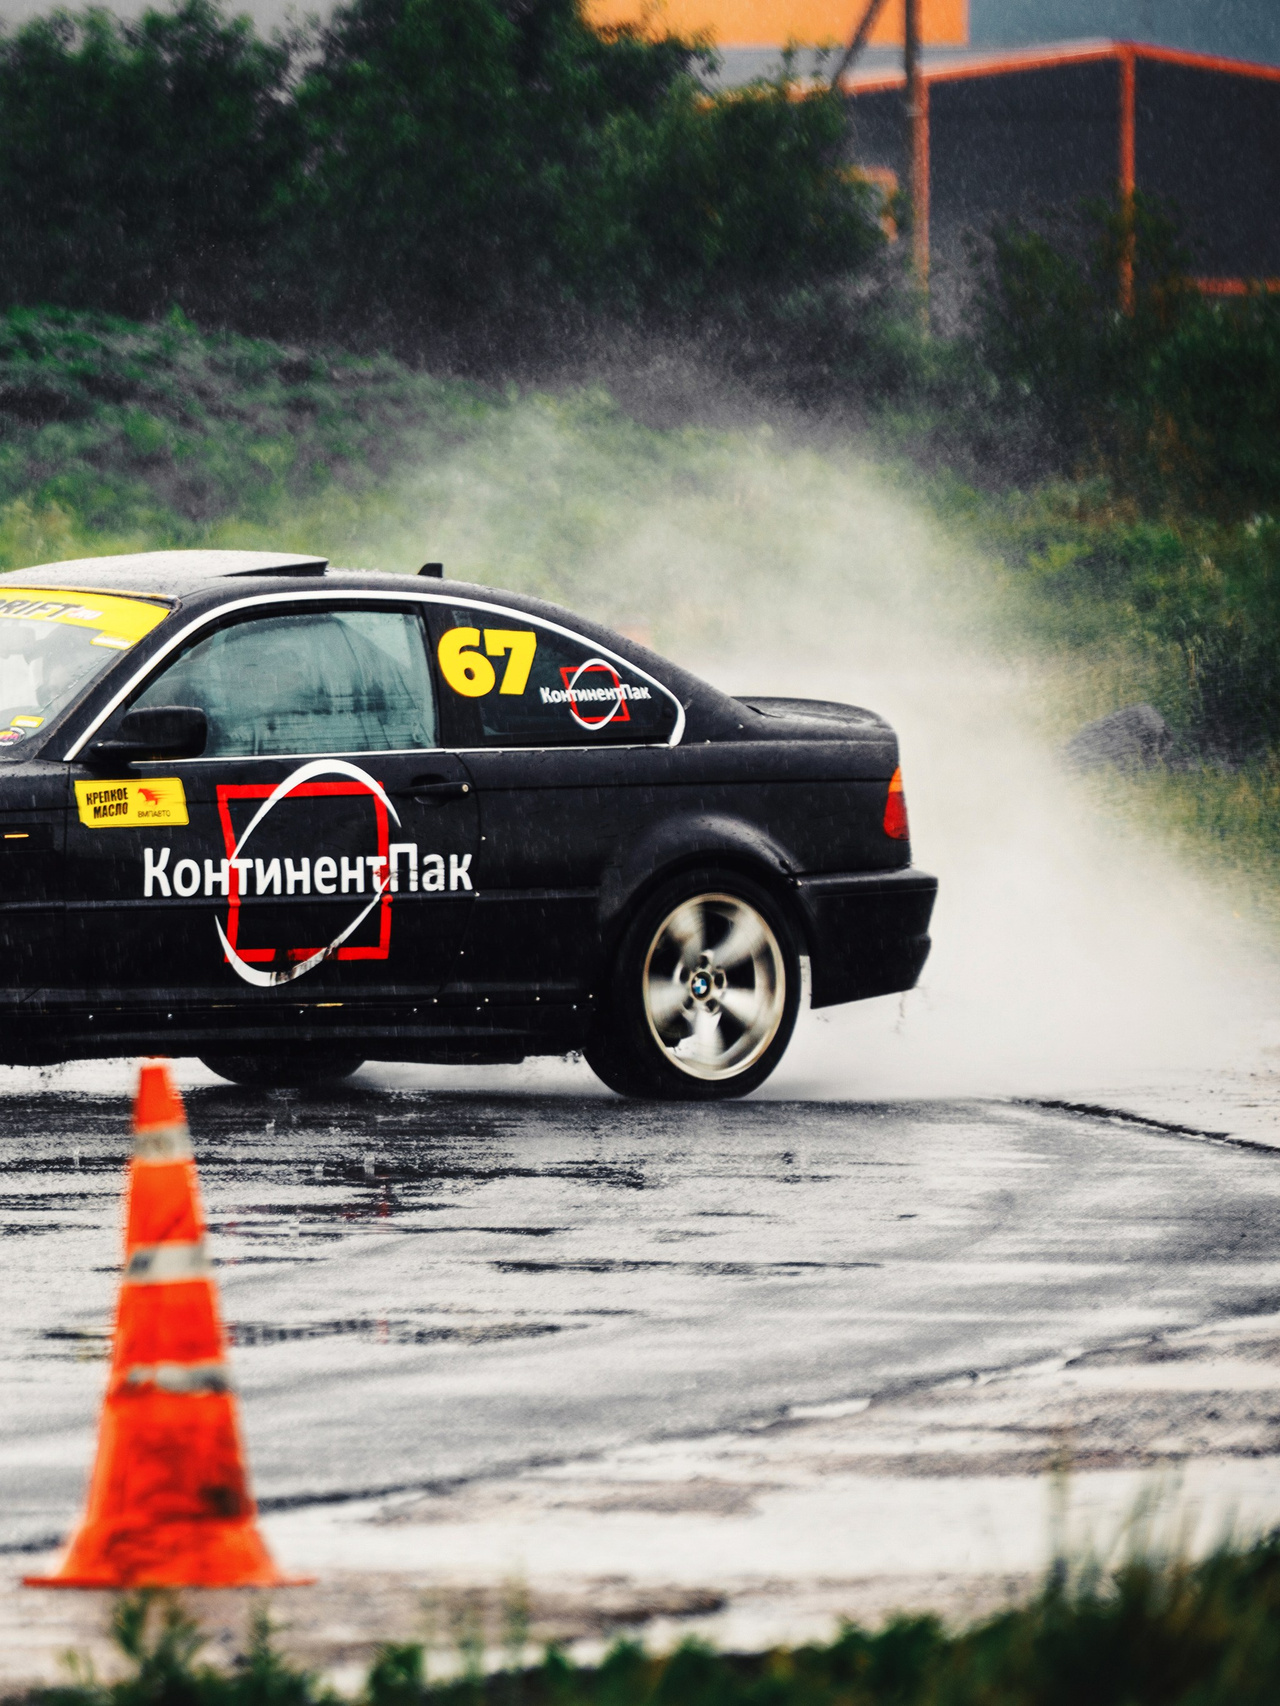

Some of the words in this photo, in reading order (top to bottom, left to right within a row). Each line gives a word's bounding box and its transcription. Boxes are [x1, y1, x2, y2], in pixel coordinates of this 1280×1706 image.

[438, 627, 537, 698] 67
[539, 684, 652, 704] КонтинентПак
[86, 787, 128, 805] КРЕПКОЕ
[93, 802, 128, 819] МАСЛО
[137, 810, 171, 818] ВМПАВТО
[143, 843, 472, 897] КонтинентПак
